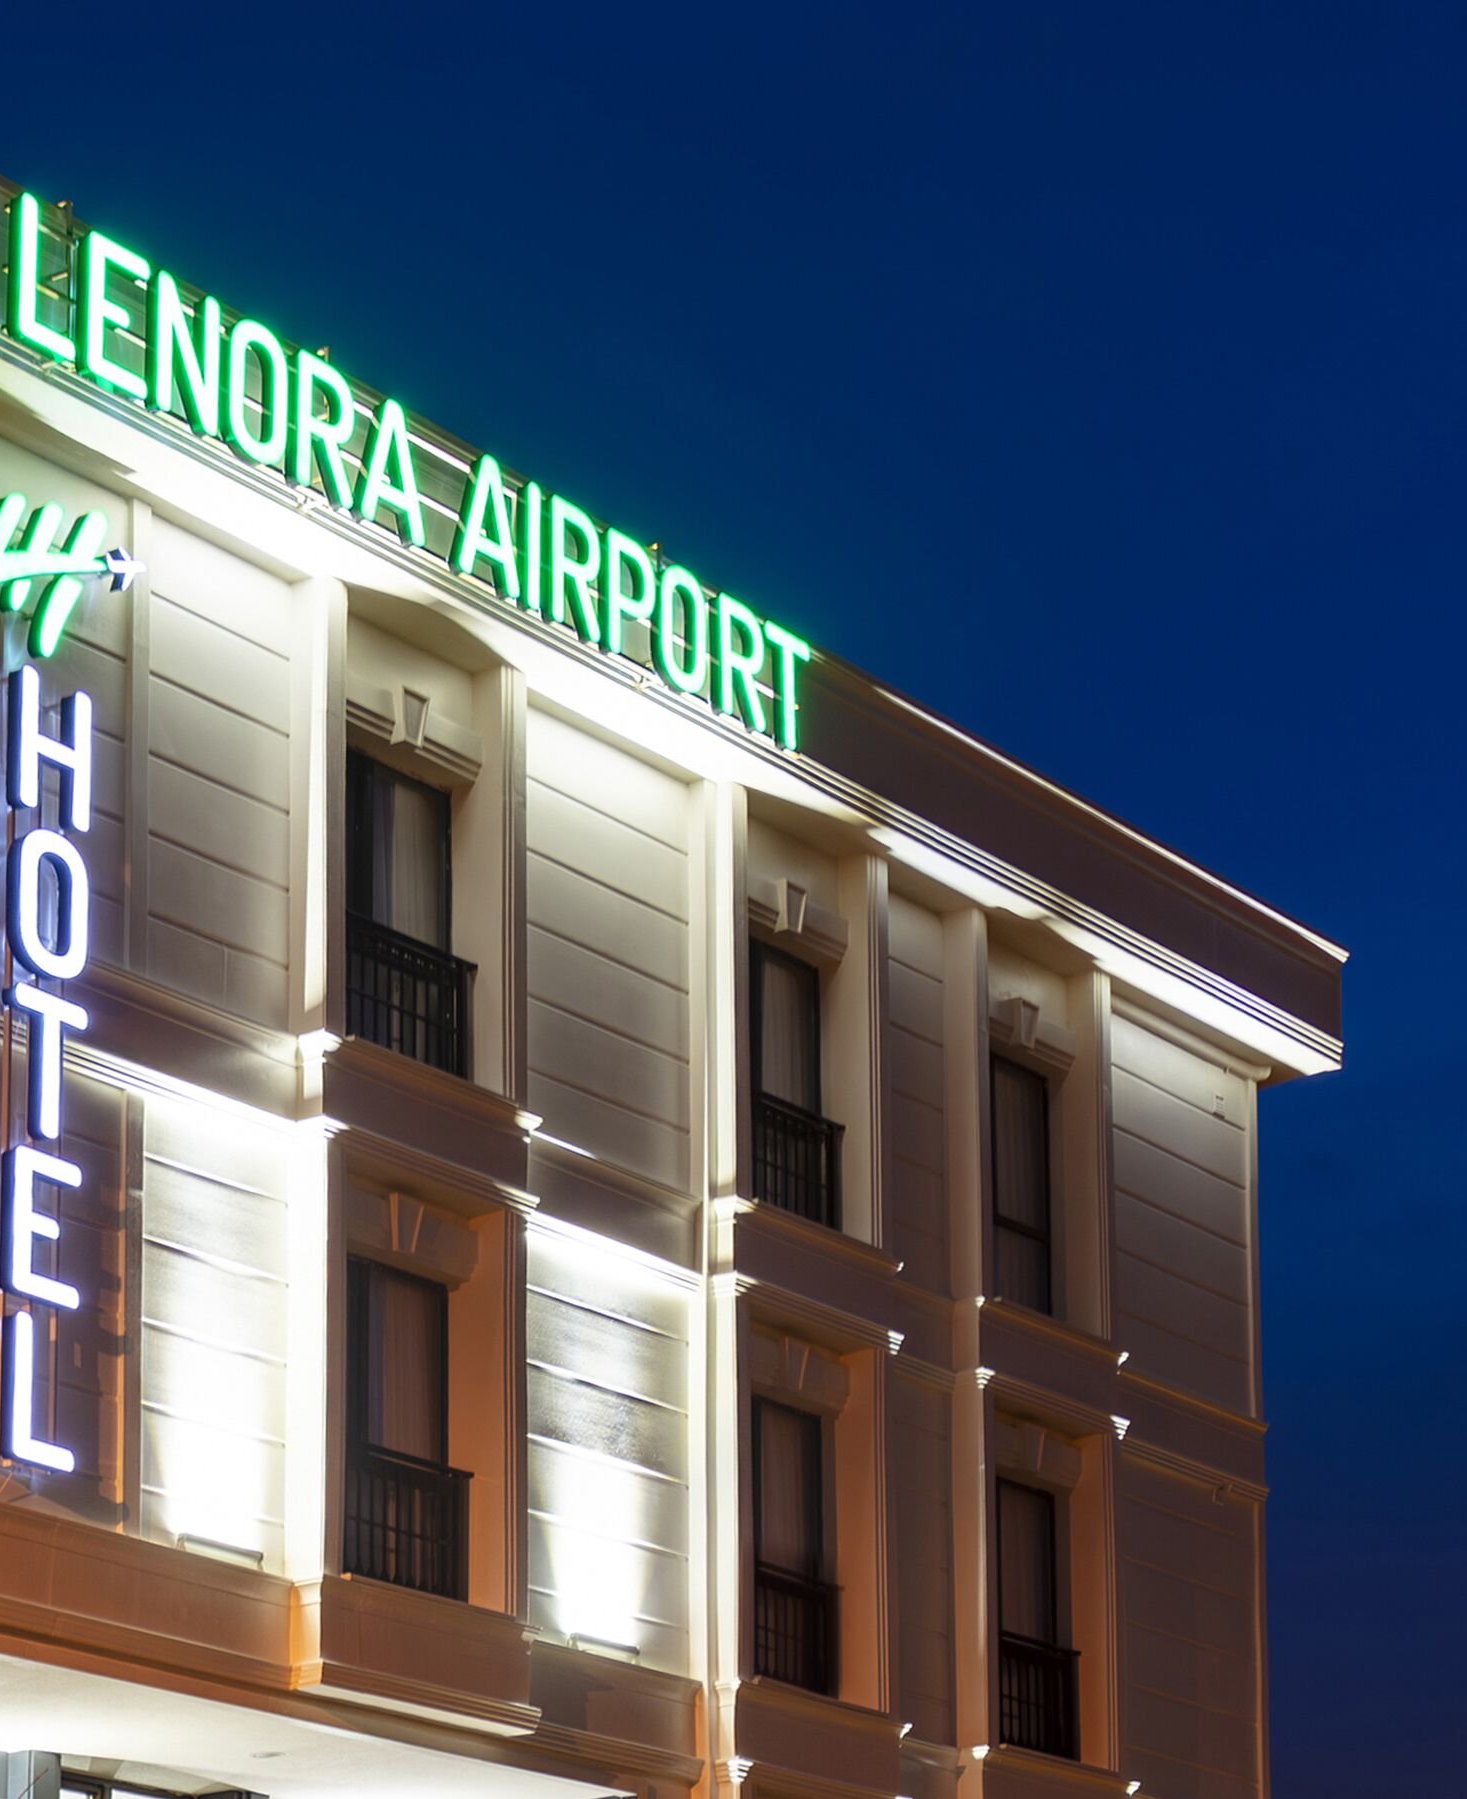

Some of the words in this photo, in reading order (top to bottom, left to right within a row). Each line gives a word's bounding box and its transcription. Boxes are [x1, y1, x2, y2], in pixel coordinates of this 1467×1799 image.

[8, 192, 427, 548] LENORA
[451, 453, 812, 752] AIRPORT
[2, 663, 93, 1474] HOTEL
